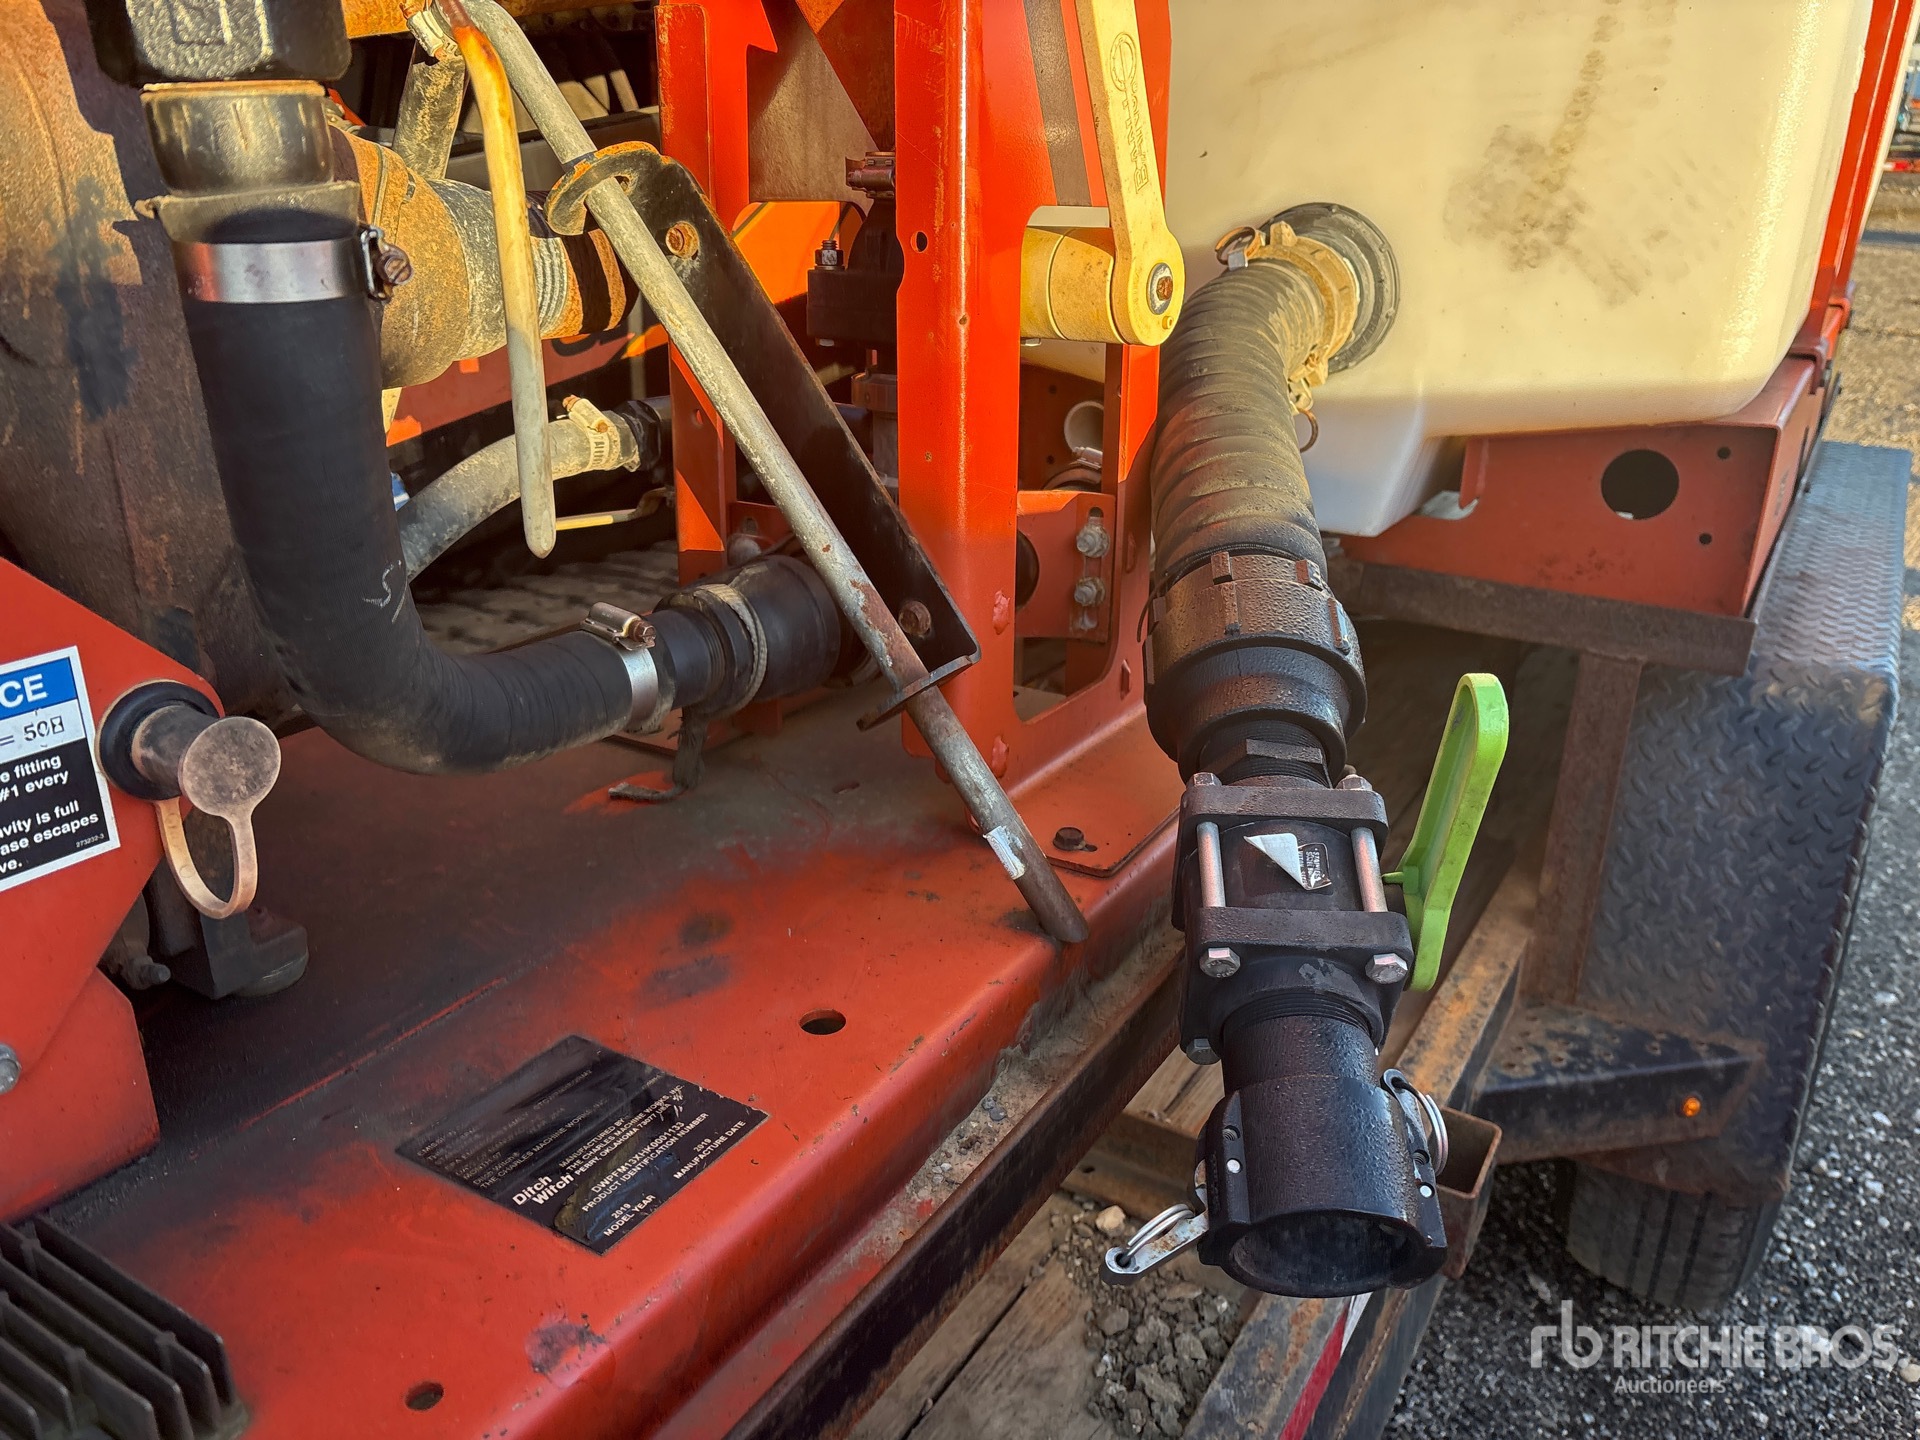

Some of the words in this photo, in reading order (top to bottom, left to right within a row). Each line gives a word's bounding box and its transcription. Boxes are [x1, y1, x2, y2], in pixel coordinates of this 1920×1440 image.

[14, 755, 62, 779] fitting
[25, 770, 69, 793] every
[33, 813, 99, 843] escapes
[36, 811, 51, 825] is
[54, 799, 80, 818] full
[557, 1124, 617, 1168] MANUFACTURED
[565, 1159, 584, 1172] THE
[580, 1134, 616, 1160] CHARLES
[612, 1112, 647, 1136] MACHINE
[573, 1155, 602, 1176] PERRY,
[597, 1126, 640, 1157] OKLAHOMA
[635, 1112, 659, 1128] 73077
[654, 1102, 672, 1114] USA
[672, 1135, 729, 1179] MANUFACTURE
[723, 1120, 747, 1136] DATE
[692, 1137, 713, 1152] 2019
[479, 1175, 499, 1189] THE
[495, 1150, 535, 1177] CHARLES
[531, 1126, 568, 1152] MACHINE
[580, 1179, 623, 1212] PRODUCT
[618, 1135, 680, 1182] IDENTIFICATION
[675, 1112, 710, 1137] NUMBER
[508, 1174, 555, 1205] Ditch
[529, 1172, 577, 1205] Witch
[602, 1211, 635, 1236] MODEL
[630, 1193, 657, 1213] YEAR
[610, 1202, 632, 1218] 2019
